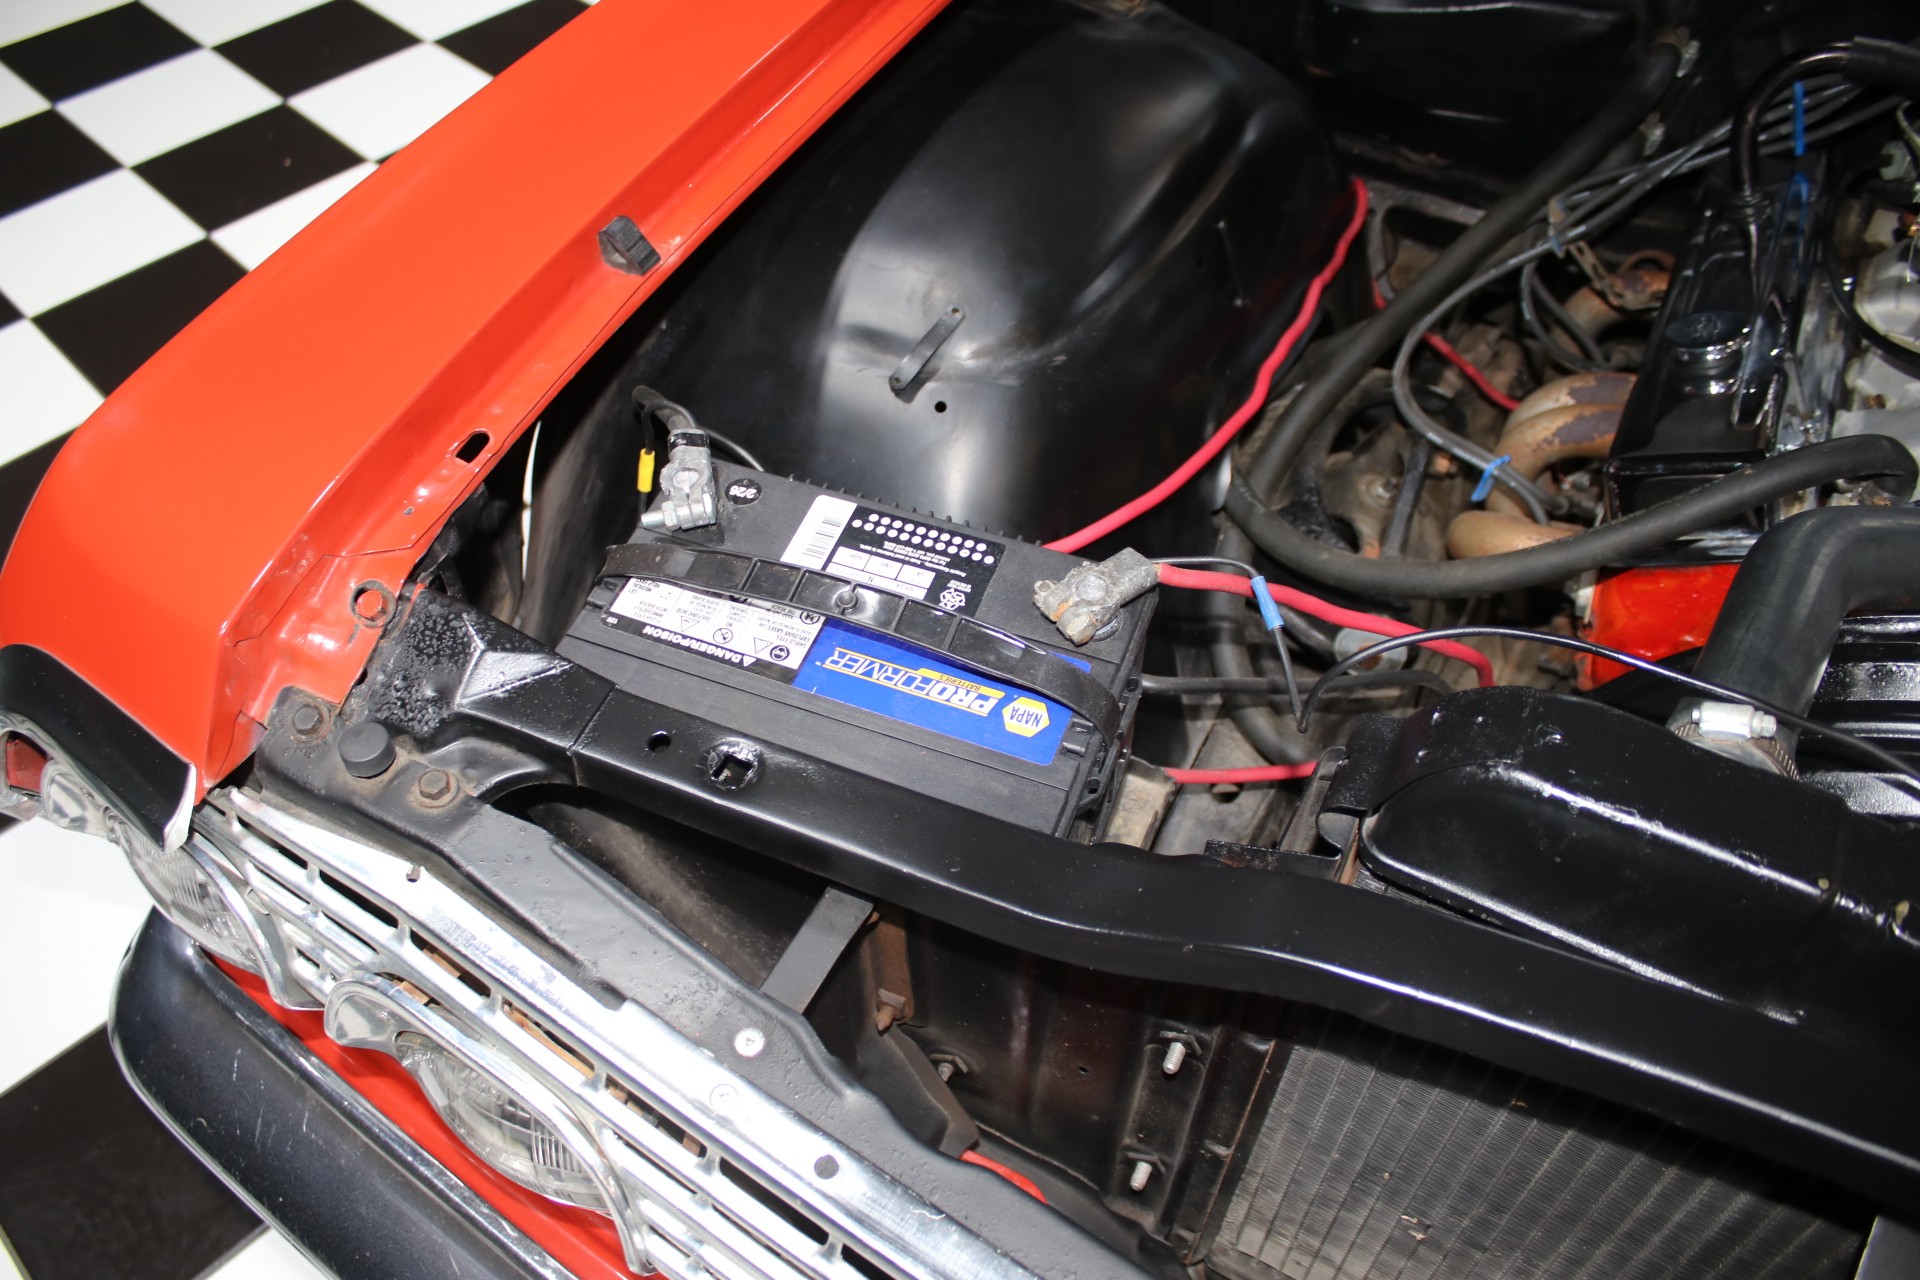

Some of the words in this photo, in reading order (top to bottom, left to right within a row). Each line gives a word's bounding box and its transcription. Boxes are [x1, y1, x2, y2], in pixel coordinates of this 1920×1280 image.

[728, 484, 757, 498] 2/26
[766, 625, 784, 634] GASES
[783, 630, 810, 642] EXPLOSIVE
[641, 624, 742, 663] DANGER/POISON
[824, 649, 999, 714] PROFORMER
[937, 673, 981, 691] BATTERIES
[1008, 706, 1043, 727] NAPA
